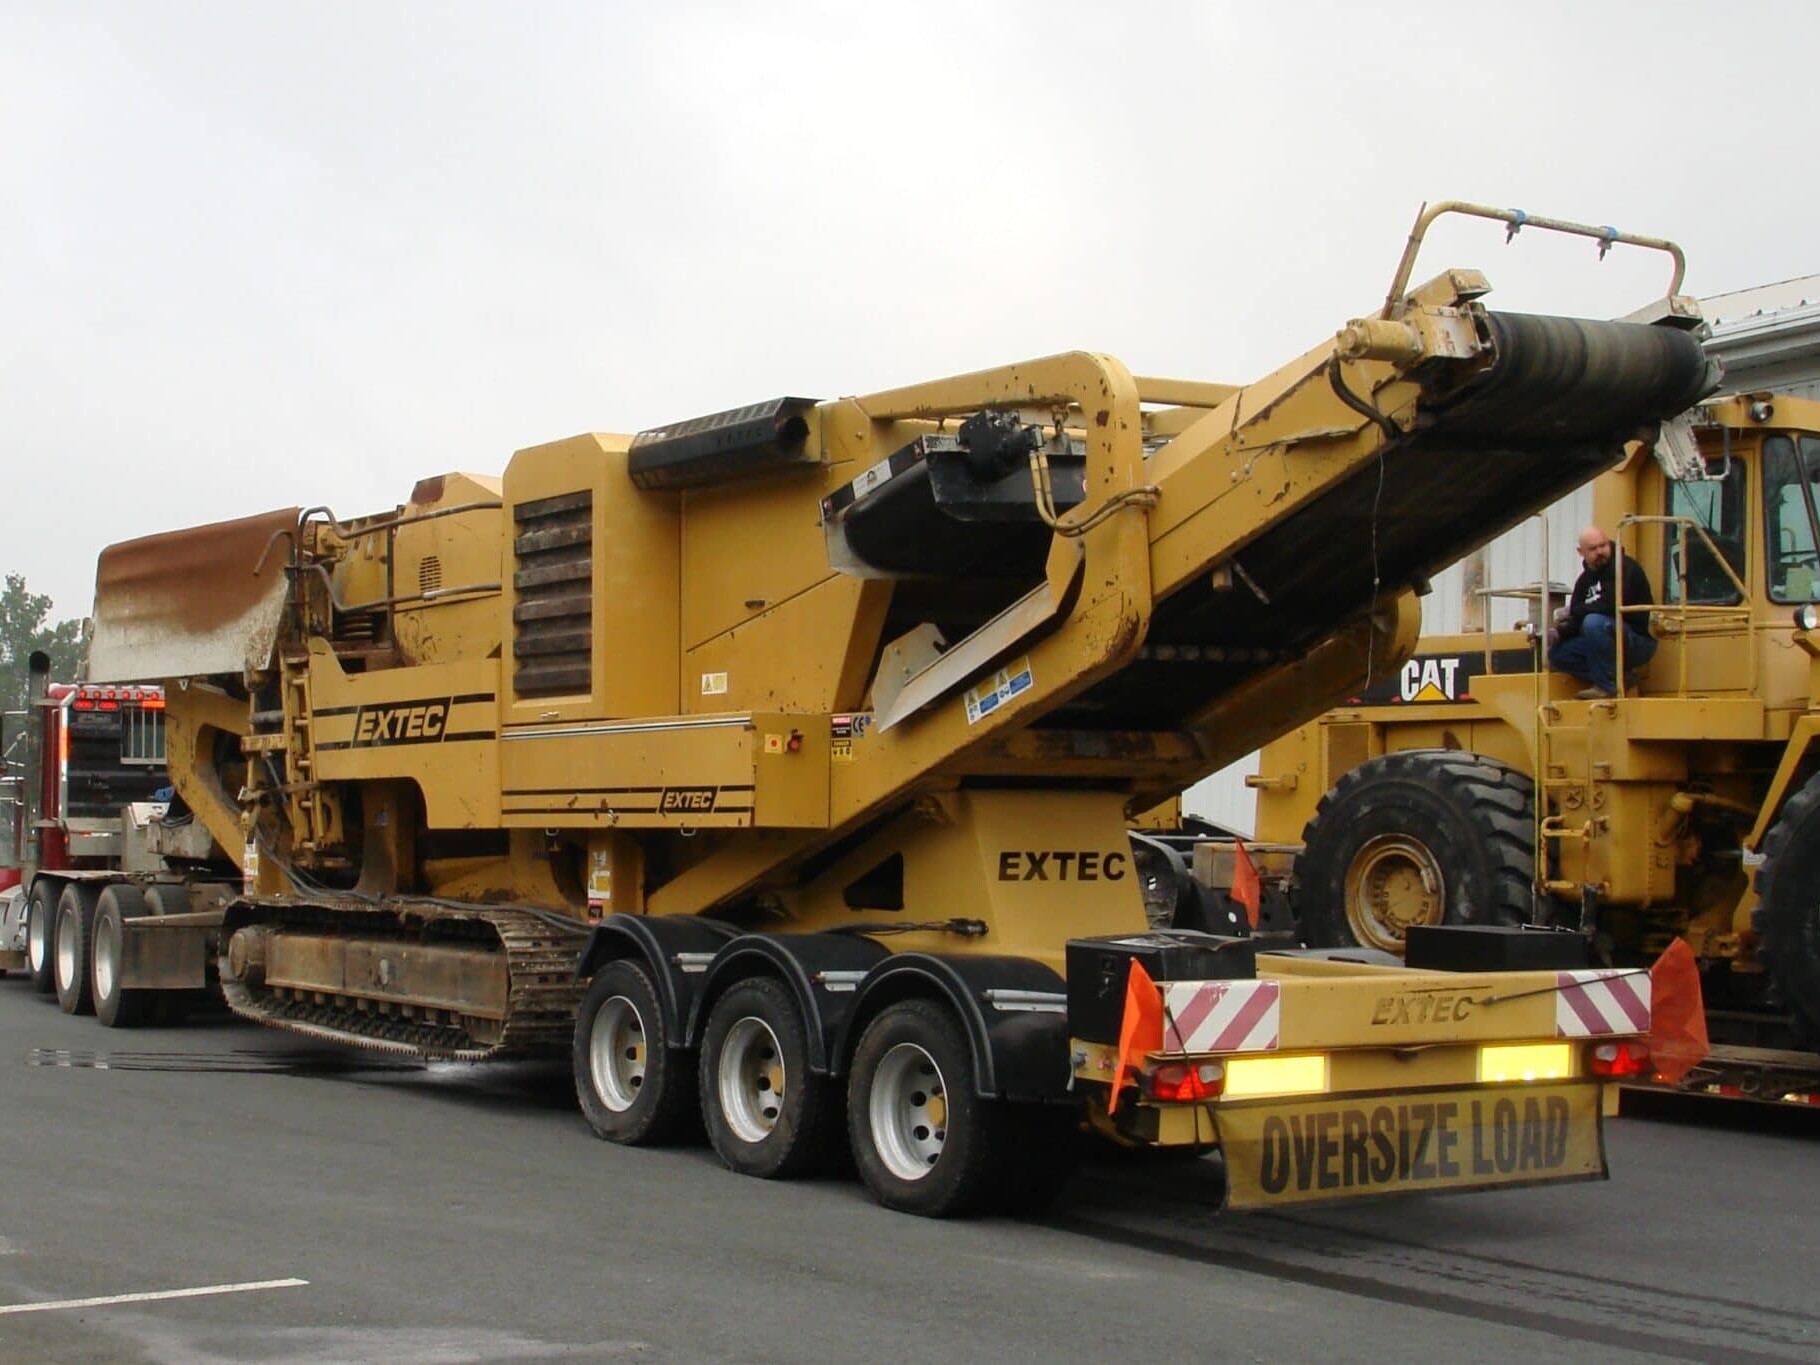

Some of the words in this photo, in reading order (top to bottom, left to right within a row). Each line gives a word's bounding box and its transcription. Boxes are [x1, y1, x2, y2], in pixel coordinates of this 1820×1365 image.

[1400, 658, 1459, 702] CAT
[357, 705, 445, 741] EXTEC
[663, 791, 712, 809] EXTEC
[998, 851, 1126, 881] EXTEC
[1371, 996, 1473, 1025] EXTEC
[1260, 1103, 1460, 1194] OVERSIZE
[1471, 1096, 1569, 1175] LOAD
